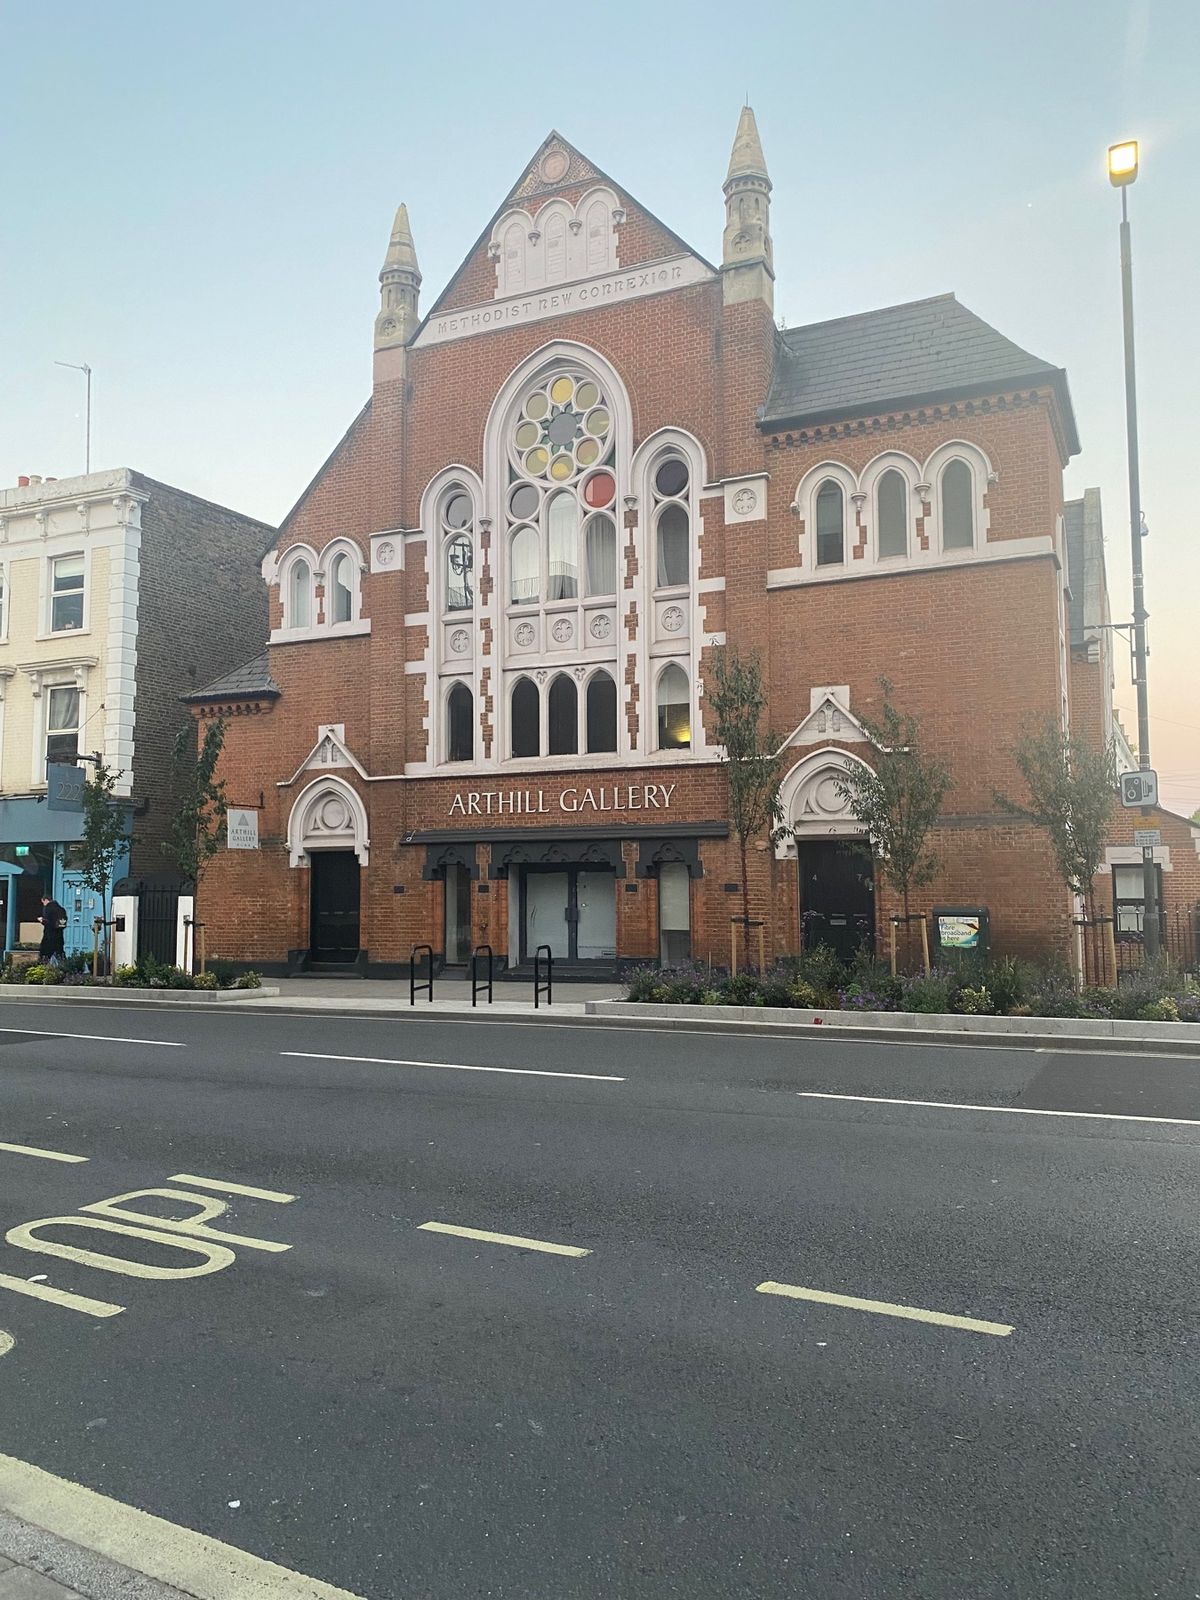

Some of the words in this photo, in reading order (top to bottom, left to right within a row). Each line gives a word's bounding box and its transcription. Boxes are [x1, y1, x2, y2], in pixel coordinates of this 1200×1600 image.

[438, 302, 532, 334] METHODIST
[538, 292, 572, 311] NEW
[578, 266, 682, 300] CONNEXION
[449, 790, 550, 815] ARTHILL
[559, 784, 676, 812] GALLERY
